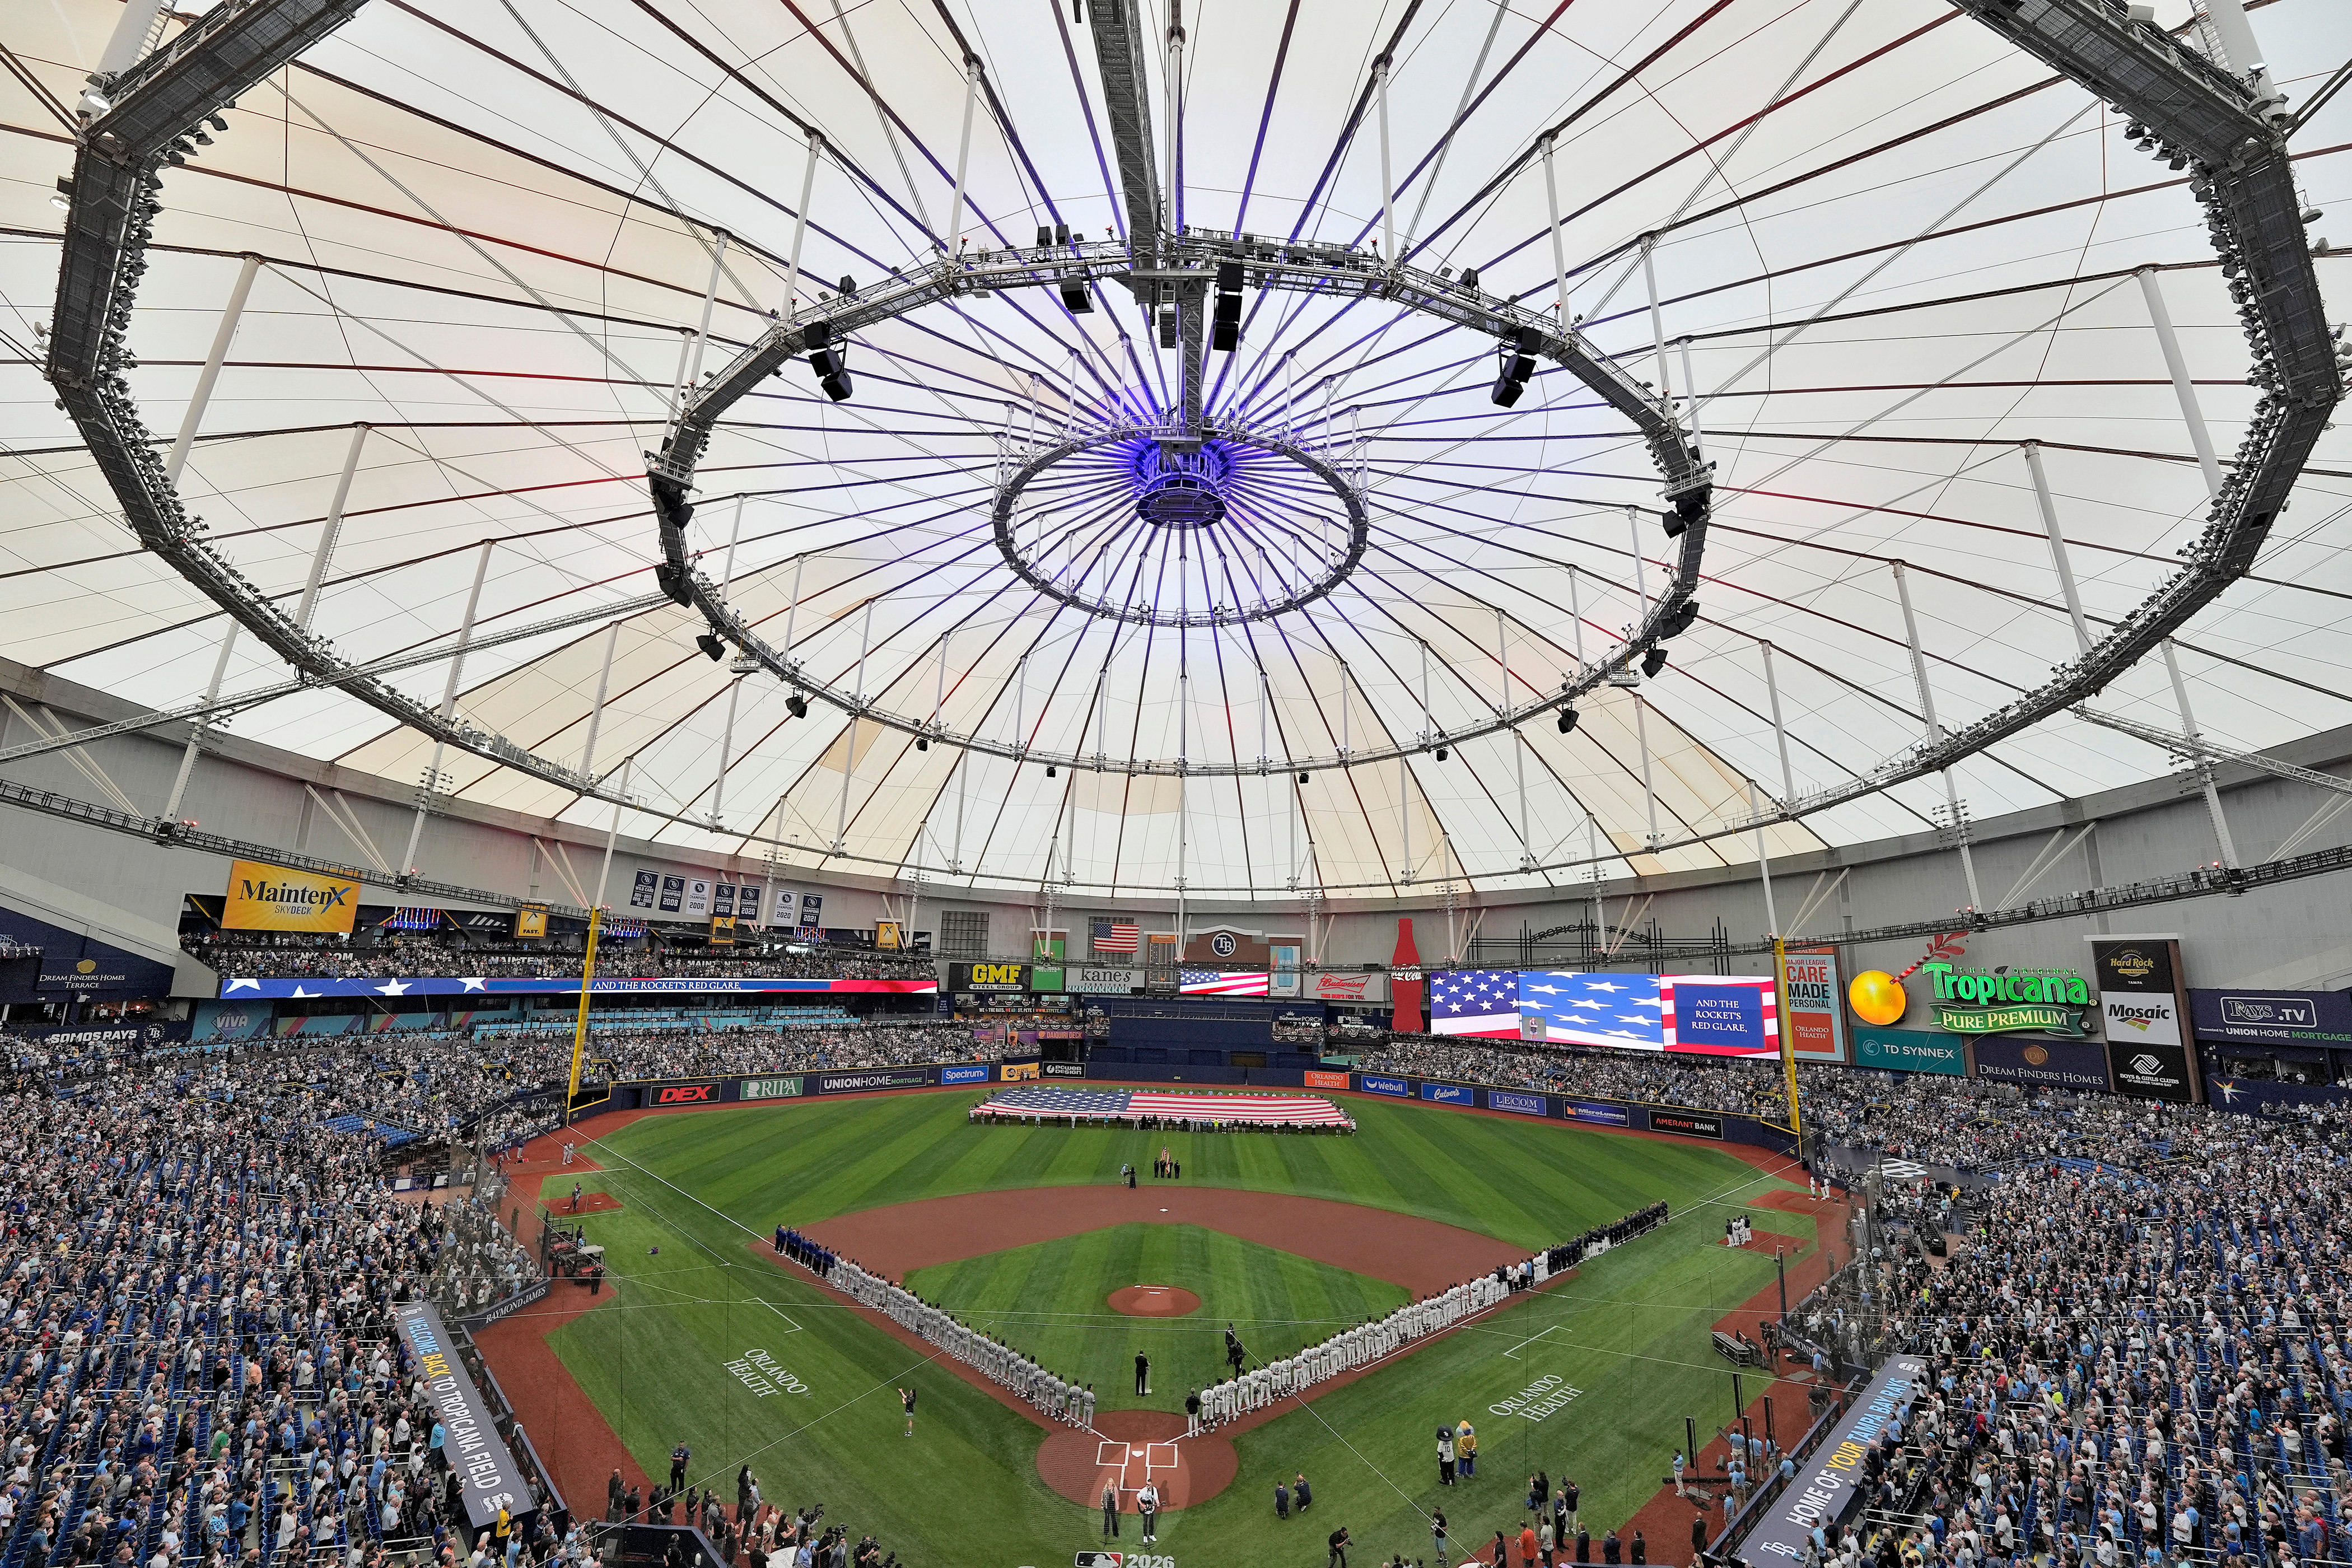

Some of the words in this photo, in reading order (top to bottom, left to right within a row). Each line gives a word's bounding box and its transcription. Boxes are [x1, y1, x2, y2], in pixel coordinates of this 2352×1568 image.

[237, 879, 351, 914] MaintenX
[662, 898, 679, 907] 2008
[274, 905, 312, 915] SKYDECK
[689, 902, 704, 910] 2008
[716, 904, 730, 913] 2010
[2110, 958, 2131, 967] Hard
[2132, 958, 2154, 968] Rock
[972, 964, 1021, 983] GMF
[1080, 969, 1132, 982] kane's
[1786, 966, 1828, 983] CARE
[618, 981, 640, 990] THE
[641, 981, 687, 990] ROCKET'S
[708, 982, 741, 991] GLARE,
[1320, 978, 1365, 988] Budweiser
[1788, 983, 1830, 999] MADE
[1922, 963, 2088, 1005] Tropicana
[1719, 1000, 1739, 1009] THE
[1789, 999, 1831, 1009] PERSONAL
[2108, 1004, 2170, 1019] Mosaic
[217, 1015, 248, 1028] VIVA
[1696, 1010, 1742, 1020] ROCKET'S
[1942, 1011, 1985, 1029] PURE
[1987, 1009, 2068, 1029] PREMIUM
[1712, 1023, 1748, 1033] GLARE,
[2226, 1028, 2258, 1037] UNION
[2260, 1029, 2290, 1038] HOME
[2292, 1031, 2352, 1042] MORTGAGE
[51, 1032, 101, 1043] SOMOS
[102, 1030, 137, 1040] RAYS
[1883, 1044, 1900, 1054] TD
[1903, 1046, 1955, 1059] SYNNEX
[946, 1069, 982, 1080] Spectrum
[1311, 1072, 1343, 1081] ORLANDO
[1978, 1063, 2016, 1077] DREAM
[2017, 1067, 2061, 1081] FINDERS
[2062, 1072, 2104, 1086] HOMES
[659, 1085, 712, 1103] DEX
[760, 1079, 798, 1096] RIPA
[1378, 1081, 1403, 1092] Webull
[1434, 1088, 1460, 1100] Culver's
[530, 1097, 548, 1110] 162
[1578, 1108, 1626, 1118] MicroLumen
[1656, 1118, 1694, 1128] AMERANT
[1695, 1122, 1716, 1132] BANK
[486, 1298, 523, 1324] RAYMOND
[523, 1286, 547, 1305] JAMES
[405, 1317, 441, 1355] WELCOME
[1781, 1329, 1814, 1357] RAYMOND
[421, 1353, 452, 1379] BACK
[744, 1348, 808, 1393] ORLANDO
[432, 1375, 458, 1392] TO
[722, 1357, 778, 1398] HEALTH
[1488, 1374, 1563, 1416] ORLANDO
[1883, 1377, 1911, 1405] RAYS
[1517, 1385, 1584, 1422] HEALTH
[1868, 1392, 1897, 1420] BAY
[438, 1390, 486, 1454] TROPICANA
[1846, 1413, 1887, 1443] TAMPA
[1825, 1441, 1866, 1472] YOUR
[464, 1451, 502, 1490] FIELD
[1814, 1469, 1844, 1491] OF
[1785, 1485, 1834, 1529] HOME
[1760, 1541, 1798, 1557] TB
[1126, 1553, 1175, 1568] 2026
